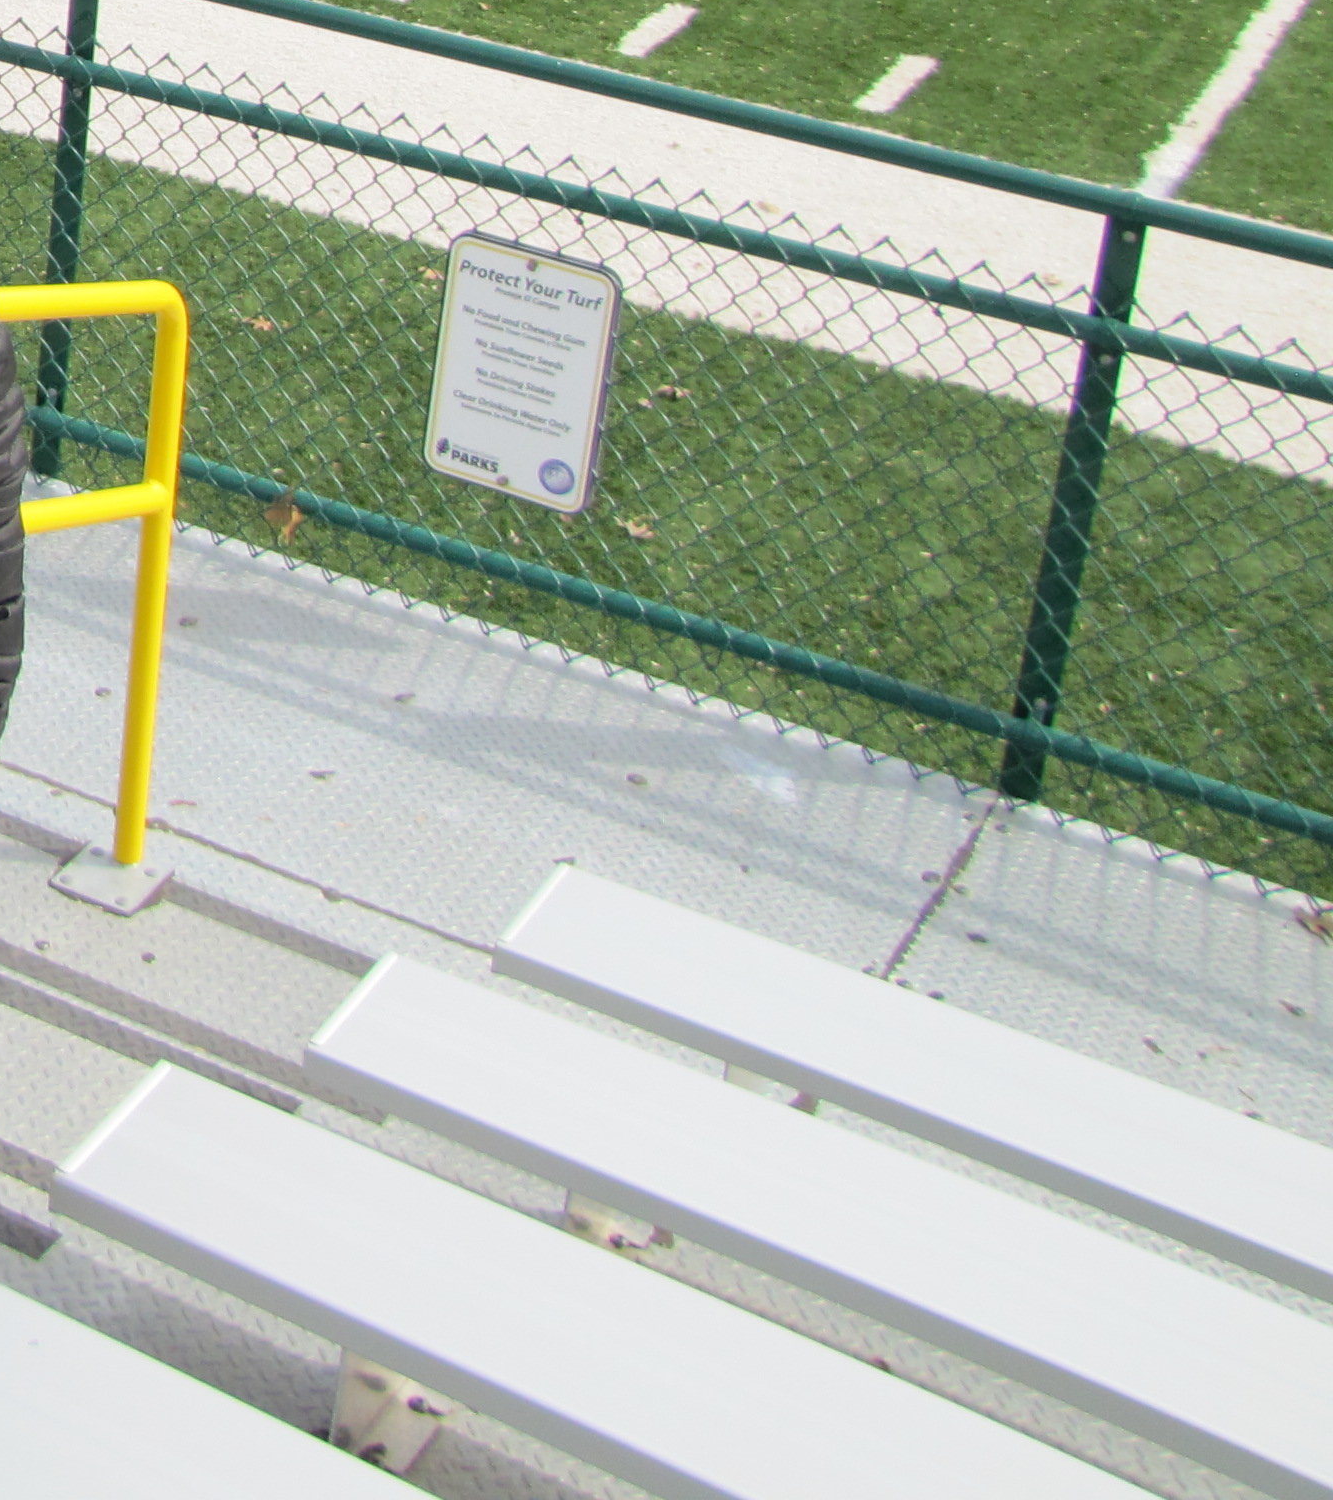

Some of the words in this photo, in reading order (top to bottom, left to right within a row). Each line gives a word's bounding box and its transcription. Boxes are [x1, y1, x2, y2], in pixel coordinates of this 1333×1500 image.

[459, 258, 521, 287] Protect
[524, 276, 563, 299] Your
[566, 288, 603, 311] Turf
[476, 307, 500, 321] Food
[501, 315, 519, 327] and
[520, 320, 561, 341] Chewing
[488, 340, 535, 362] Sunflower
[537, 355, 564, 370] Seeds
[547, 417, 572, 433] Only
[450, 448, 499, 474] PARKS
